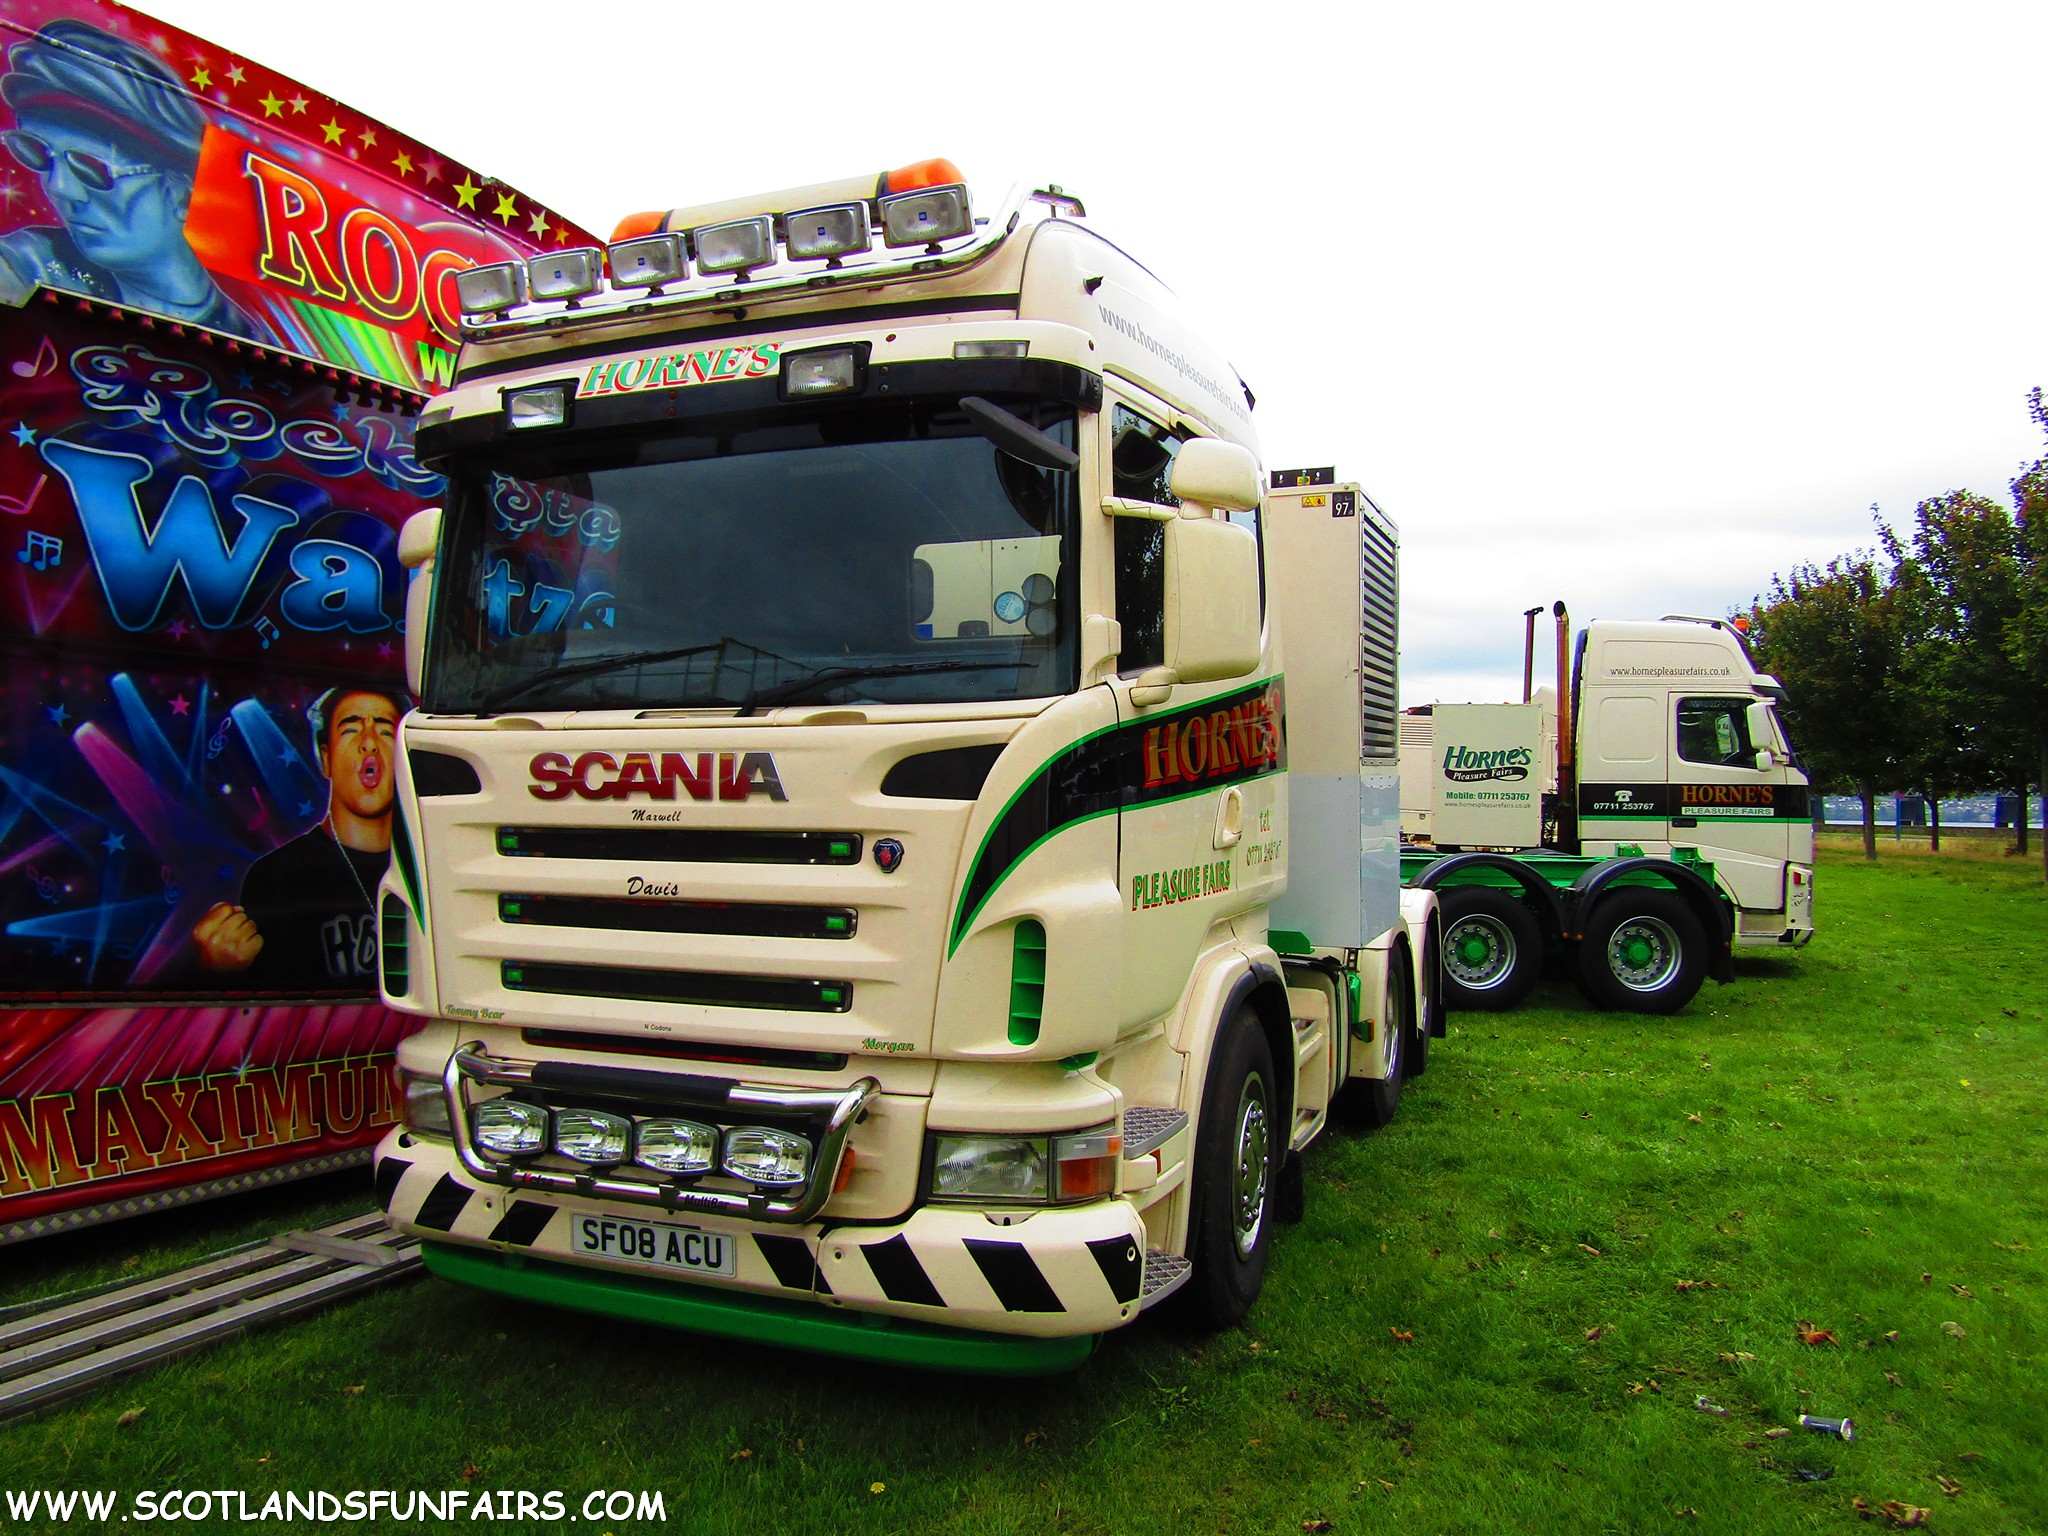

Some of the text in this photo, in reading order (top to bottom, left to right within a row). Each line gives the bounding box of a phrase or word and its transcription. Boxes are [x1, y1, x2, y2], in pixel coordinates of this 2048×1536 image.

[579, 342, 784, 397] HORNE'S
[1335, 502, 1349, 516] 97
[1609, 666, 1731, 678] www.hornespleasurefairs.co.uk
[527, 750, 790, 803] SCANIA
[1452, 767, 1513, 781] Pleasure Fairs
[1446, 791, 1530, 801] Mobile: 07711 253767
[1681, 785, 1773, 804] HORNE'S
[1444, 801, 1532, 809] www.hornespleasurefairs.co.uk
[1593, 802, 1655, 811] 07711 253767
[1683, 807, 1772, 816] PLEASURE FAIRS
[631, 809, 682, 822] Maxwell
[626, 875, 680, 897] Davis
[1131, 860, 1231, 911] PLEASURE FAIRS
[444, 1003, 479, 1020] Tommy
[650, 1024, 672, 1032] Codona
[861, 1037, 916, 1053] Morgan
[684, 1193, 730, 1211] MultiBar
[582, 1218, 722, 1269] SF08 ACU
